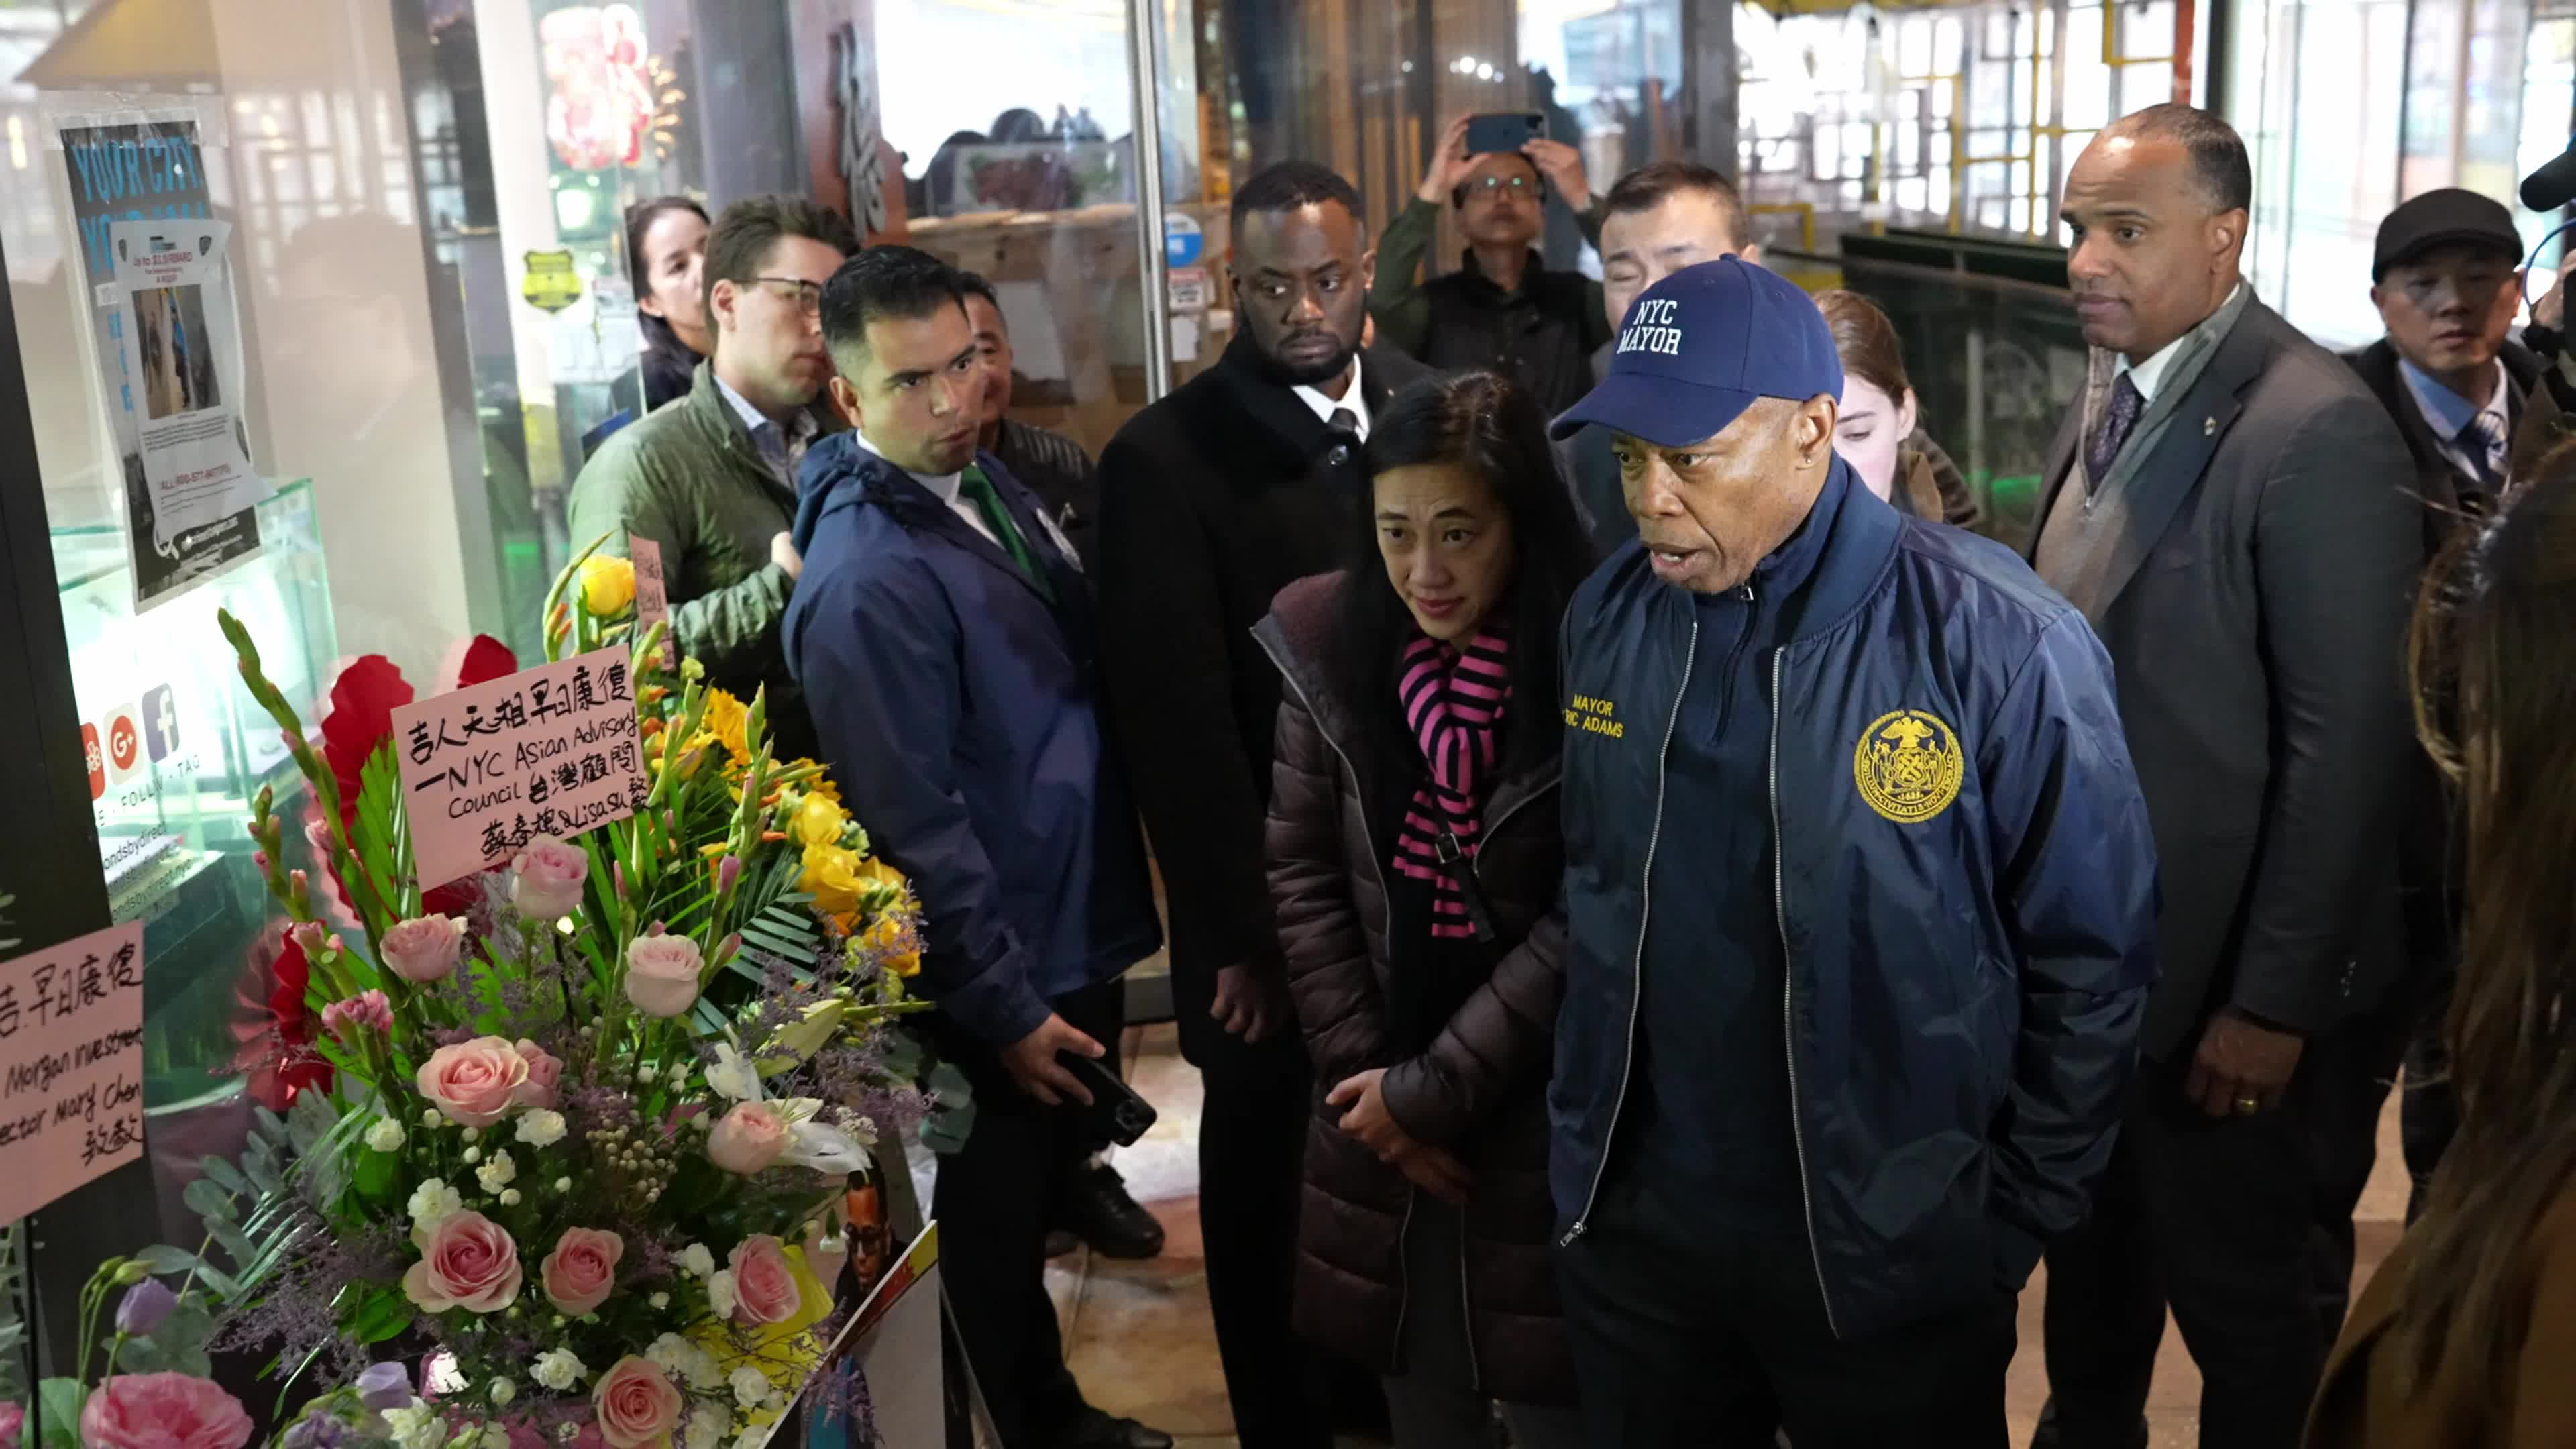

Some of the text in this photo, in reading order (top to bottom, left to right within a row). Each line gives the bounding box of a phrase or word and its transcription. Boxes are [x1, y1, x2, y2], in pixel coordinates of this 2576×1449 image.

[70, 138, 144, 203] YOUR
[1632, 299, 1678, 326] NYC
[1617, 325, 1682, 355] MAYOR
[1572, 694, 1614, 717] MAYOR
[515, 737, 569, 772] Asian
[573, 706, 639, 748] Advisory
[1582, 715, 1624, 738] ADAMS
[177, 753, 200, 778] TAG
[448, 782, 522, 819] Council
[5, 1053, 70, 1100] Morgan
[52, 1081, 97, 1128] Mary
[103, 1072, 141, 1111] Chen
